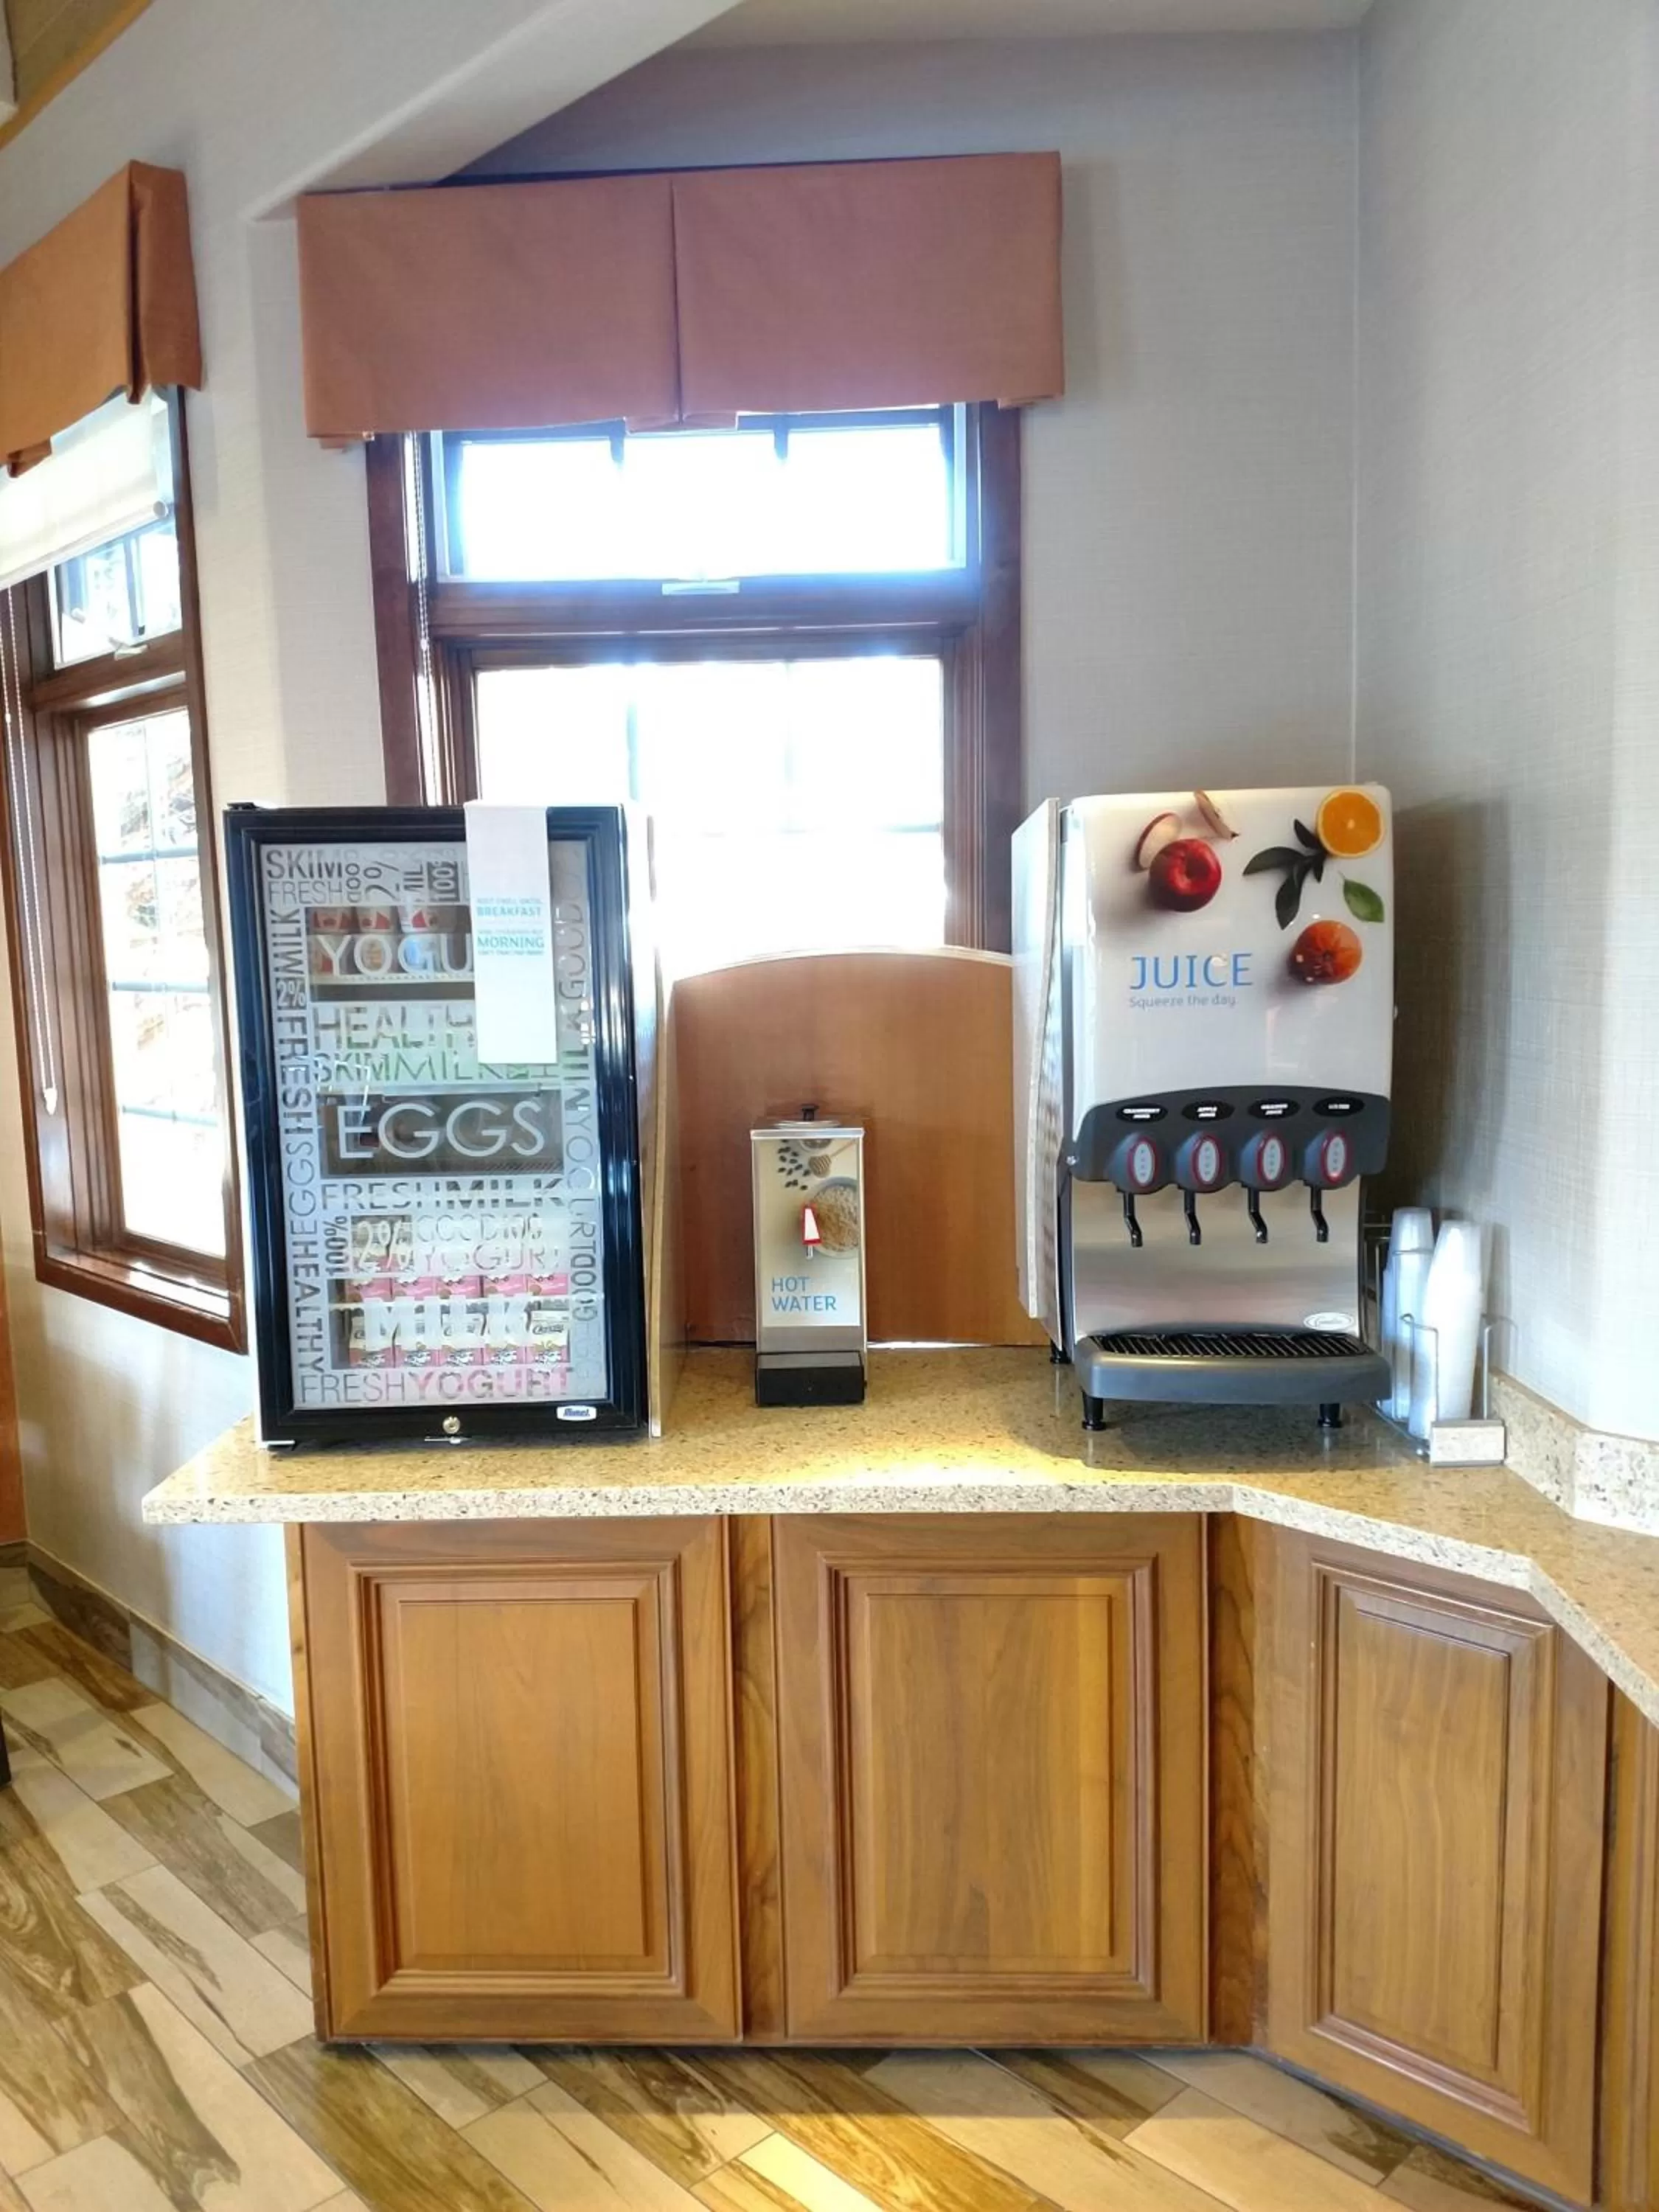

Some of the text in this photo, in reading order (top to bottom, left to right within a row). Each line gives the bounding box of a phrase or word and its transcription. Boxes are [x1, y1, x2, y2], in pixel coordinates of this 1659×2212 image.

[268, 880, 344, 905] FRESH
[476, 906, 541, 917] BREAKFAST
[271, 908, 305, 975] MILK
[317, 933, 474, 976] YOGU
[476, 936, 544, 948] MORNING
[1129, 952, 1253, 990] JUICE
[276, 978, 306, 1008] 2%
[1129, 993, 1237, 1012] Squeeze the day
[313, 1005, 476, 1051] HEALTH
[277, 1016, 313, 1134] FRESH
[337, 1100, 545, 1159] EGGS
[286, 1141, 319, 1235] EGGS
[325, 1216, 349, 1275] 100%
[771, 1295, 837, 1312] WATER
[772, 1276, 811, 1293] HOT
[292, 1240, 325, 1374] HEALTHY
